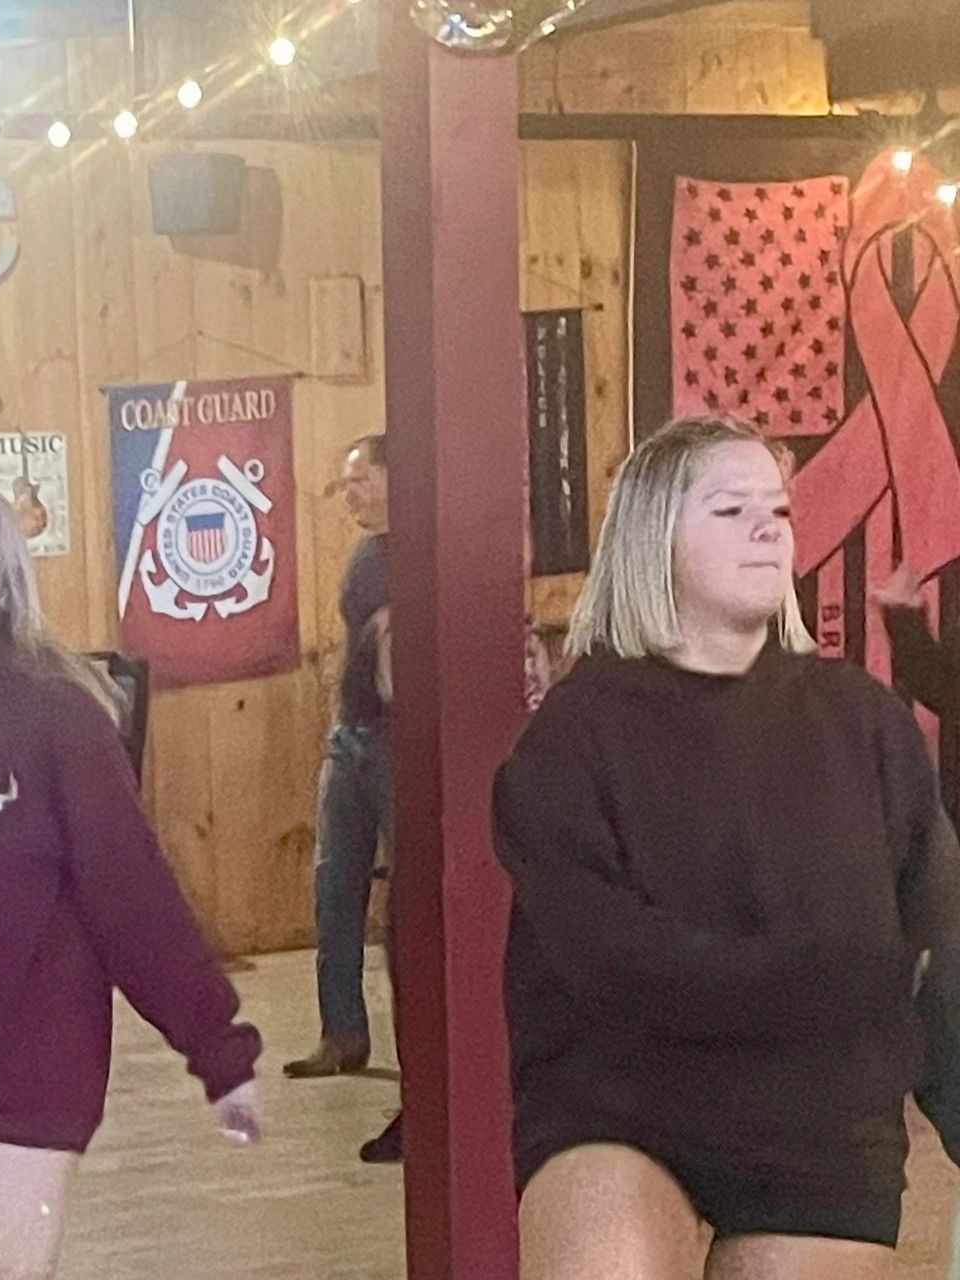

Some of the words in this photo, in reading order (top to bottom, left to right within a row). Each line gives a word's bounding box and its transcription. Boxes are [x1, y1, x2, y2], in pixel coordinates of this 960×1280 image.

[120, 396, 195, 432] COAST
[196, 389, 277, 425] GUARD
[166, 484, 208, 523] STATES
[211, 484, 249, 522] COAST
[227, 526, 252, 579] GUARD
